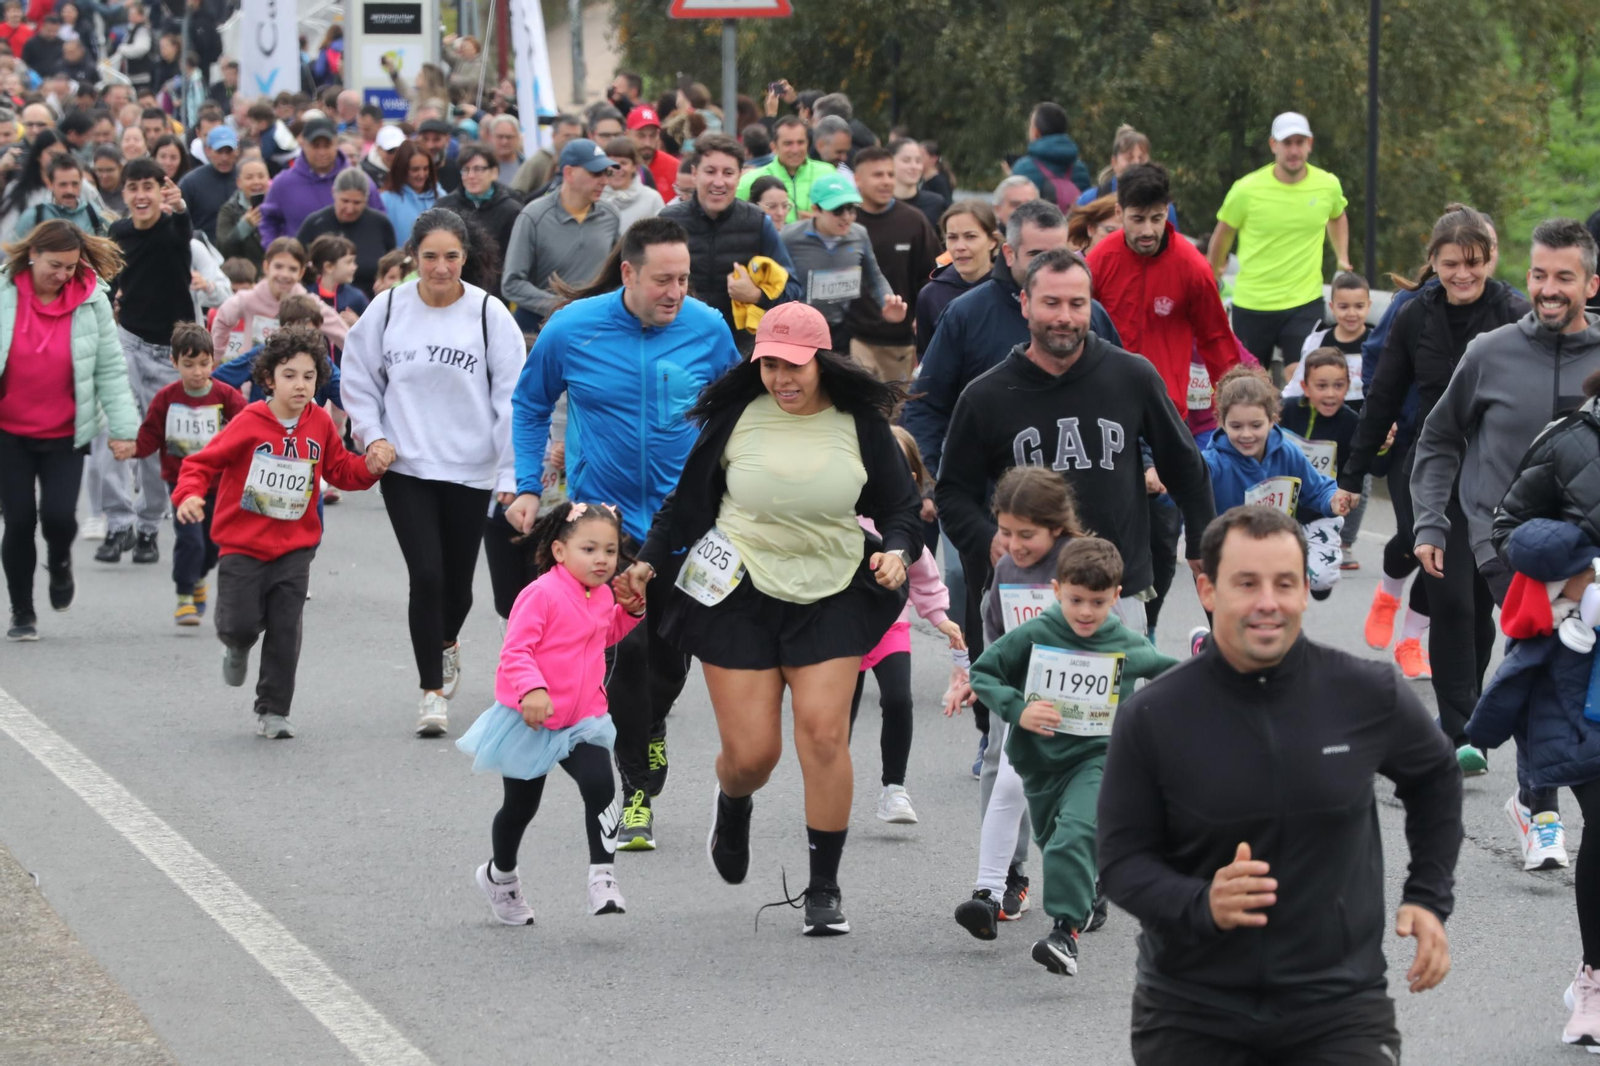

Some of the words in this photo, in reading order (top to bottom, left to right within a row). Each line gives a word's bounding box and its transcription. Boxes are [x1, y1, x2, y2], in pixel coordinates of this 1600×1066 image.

[426, 345, 478, 374] YORK
[176, 418, 216, 435] 11515
[253, 436, 321, 463] AP
[1012, 416, 1125, 472] GAP
[1305, 454, 1330, 470] 49
[259, 468, 307, 492] 10102
[697, 536, 733, 571] 2025
[1069, 658, 1091, 668] JACOBO
[1045, 668, 1109, 696] 11990
